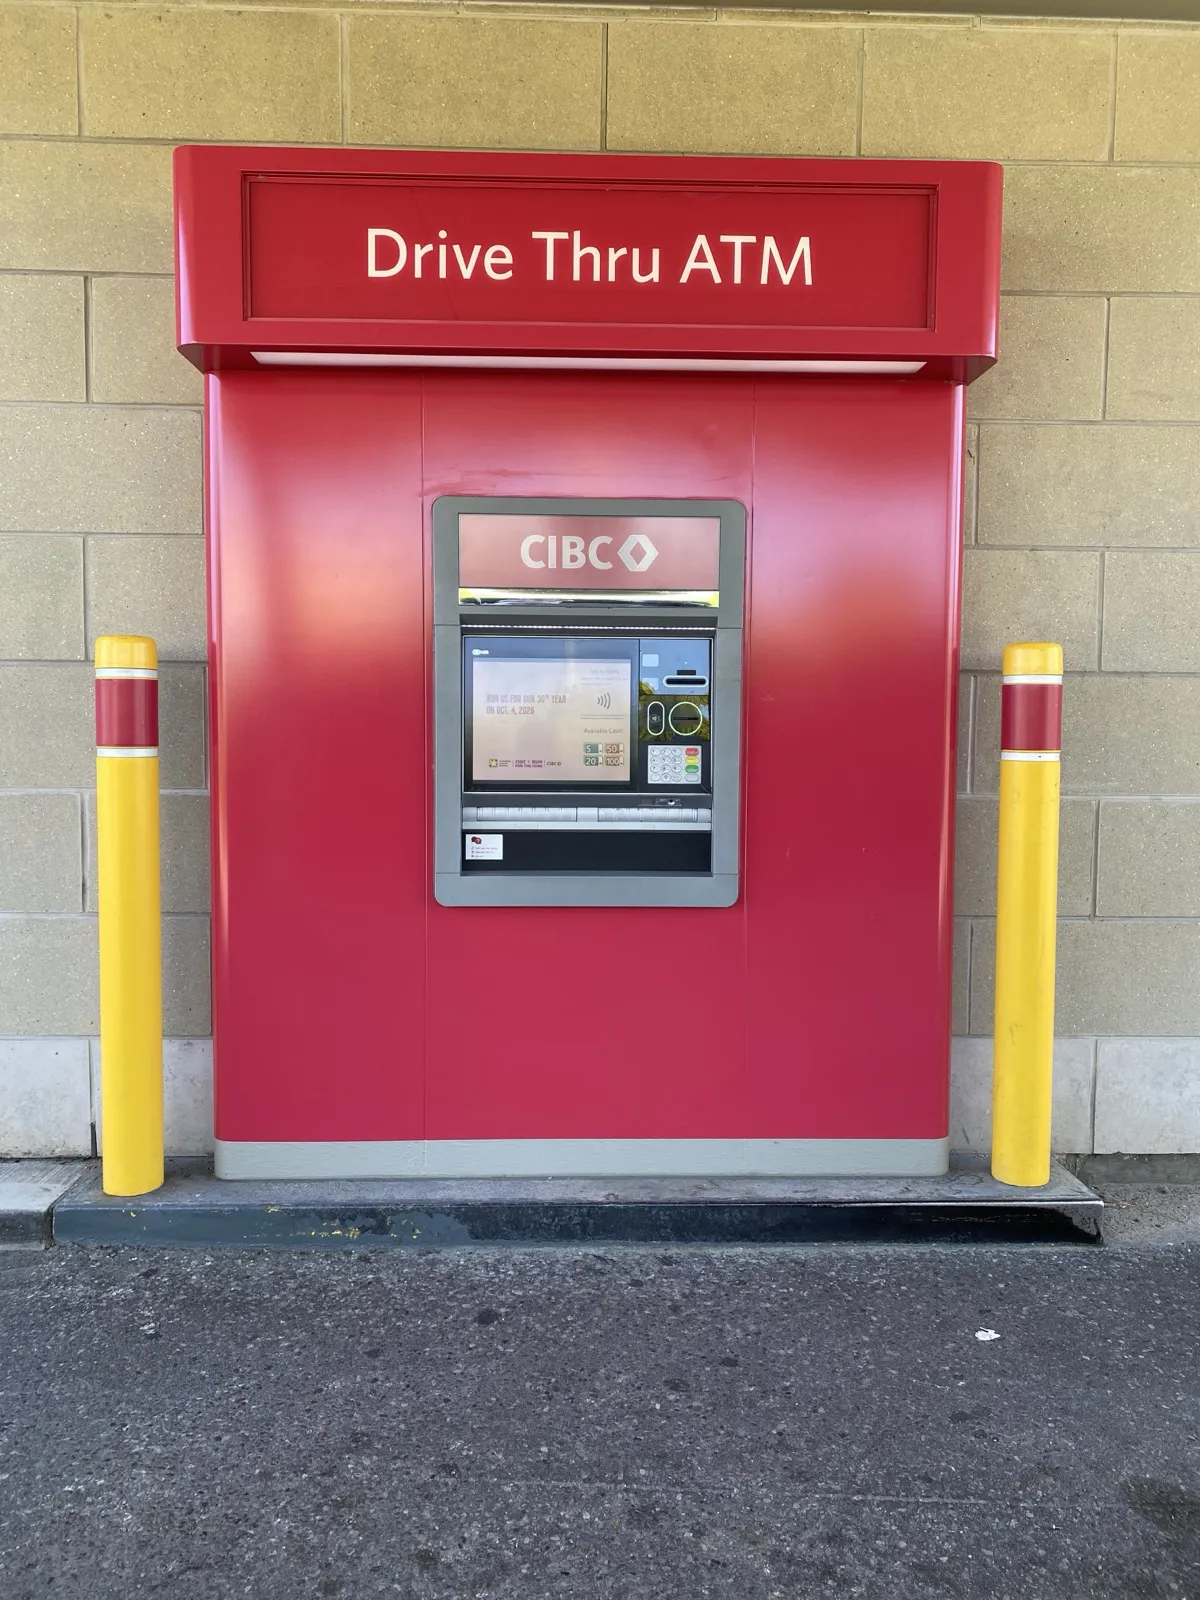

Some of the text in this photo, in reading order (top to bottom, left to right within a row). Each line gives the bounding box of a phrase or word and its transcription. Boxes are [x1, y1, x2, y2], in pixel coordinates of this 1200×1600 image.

[366, 228, 813, 286] Drive Thru ATM
[520, 534, 614, 571] CIBC
[486, 694, 499, 703] JOIN
[501, 694, 509, 703] US
[510, 694, 522, 703] FOR
[523, 694, 536, 703] OUR
[551, 694, 567, 703] YEAR
[486, 706, 495, 715] ON
[518, 706, 535, 715] 2026
[586, 744, 618, 753] 5 50
[585, 757, 620, 766] 20 100
